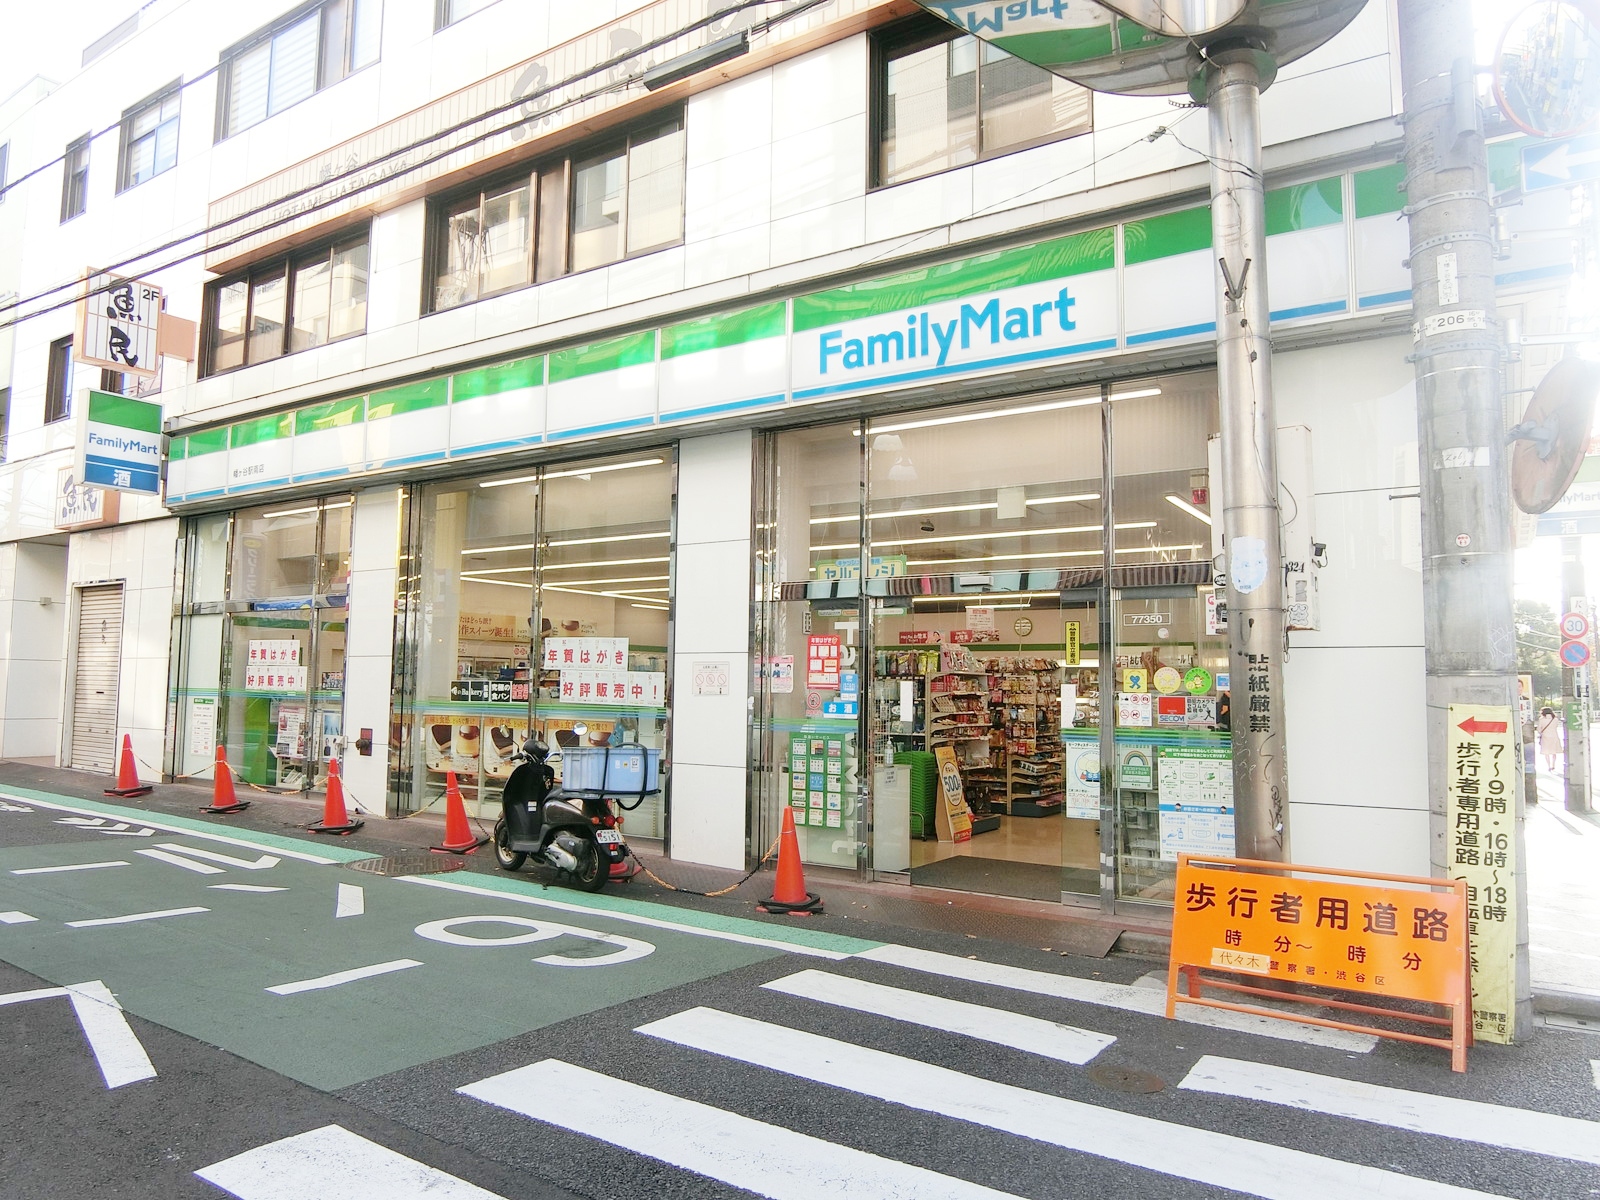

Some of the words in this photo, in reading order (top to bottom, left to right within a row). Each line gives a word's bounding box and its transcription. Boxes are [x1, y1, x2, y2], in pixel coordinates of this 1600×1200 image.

[142, 288, 160, 302] 2F
[1437, 314, 1465, 328] 206
[819, 287, 1076, 374] FamilyMart
[88, 432, 158, 455] FamilyMart
[113, 469, 131, 487] 酒
[1561, 520, 1578, 534] 酒
[1131, 615, 1163, 624] 77350
[1566, 620, 1583, 632] 30
[250, 648, 297, 661] 年賀はがき
[547, 648, 624, 665] 年賀はがき
[247, 674, 303, 688] 好評販売中！
[491, 692, 510, 700] 食パン
[562, 682, 658, 700] 好評販売中！
[1248, 654, 1270, 733] 貼紙厳禁
[828, 703, 853, 714] お酒
[1186, 882, 1449, 943] 歩行者用道路
[1225, 929, 1242, 946] 時
[1347, 945, 1367, 963] 時
[1402, 952, 1422, 971] 分
[1219, 952, 1260, 968] 代々木
